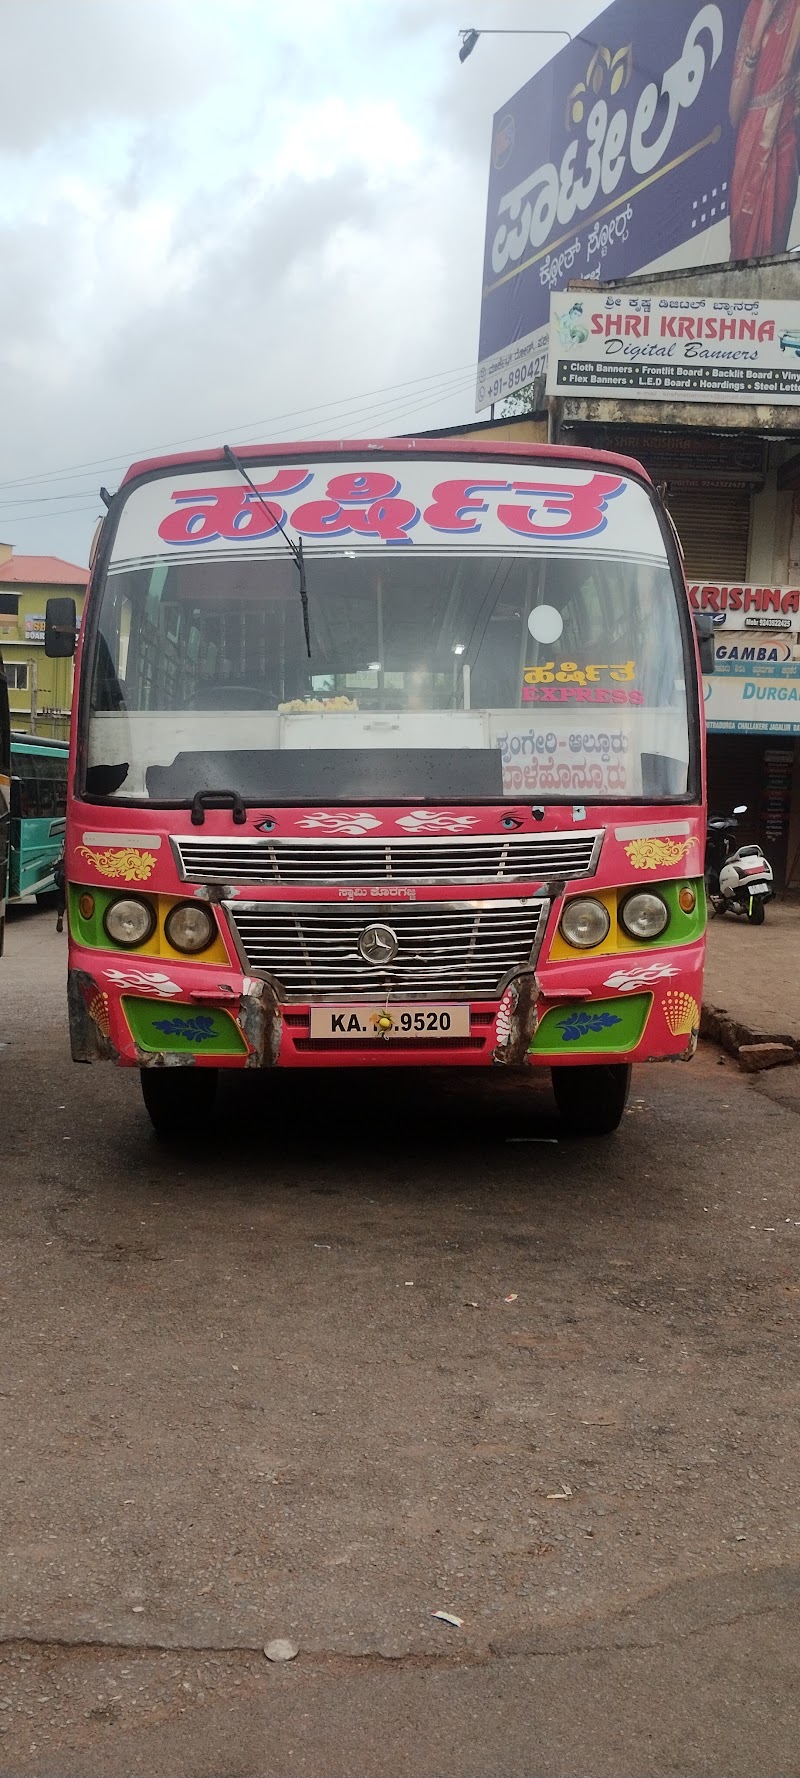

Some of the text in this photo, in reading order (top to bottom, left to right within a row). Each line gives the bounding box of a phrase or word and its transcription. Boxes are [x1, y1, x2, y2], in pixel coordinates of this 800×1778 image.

[604, 296, 621, 309] ಶ್ರೀ
[629, 298, 652, 312] ಕೃಷ್ಣ
[659, 299, 706, 309] ಡಿಜಿಟಲ್
[591, 313, 775, 342] SHRI KRISHNA
[604, 338, 759, 361] Digital Banners
[570, 363, 593, 372] Cloth
[596, 364, 633, 374] Banners
[642, 366, 675, 376] Frontlit
[677, 367, 703, 377] Board
[712, 369, 744, 378] Backlit
[746, 370, 773, 379] Board
[569, 374, 588, 383] Flex
[590, 375, 627, 385] Banners
[639, 377, 662, 386] L.E.D
[664, 378, 691, 387] Board
[700, 380, 745, 391] Hoardings
[754, 382, 777, 391] Steel
[157, 469, 626, 544] ಹರ್ಷಿತ
[687, 586, 800, 614] KRISHNA
[523, 660, 636, 686] ಹರ್ಷಿತ
[521, 686, 645, 705] EXPRESS
[743, 682, 800, 700] DURGA
[331, 1012, 451, 1032] KA..9520
